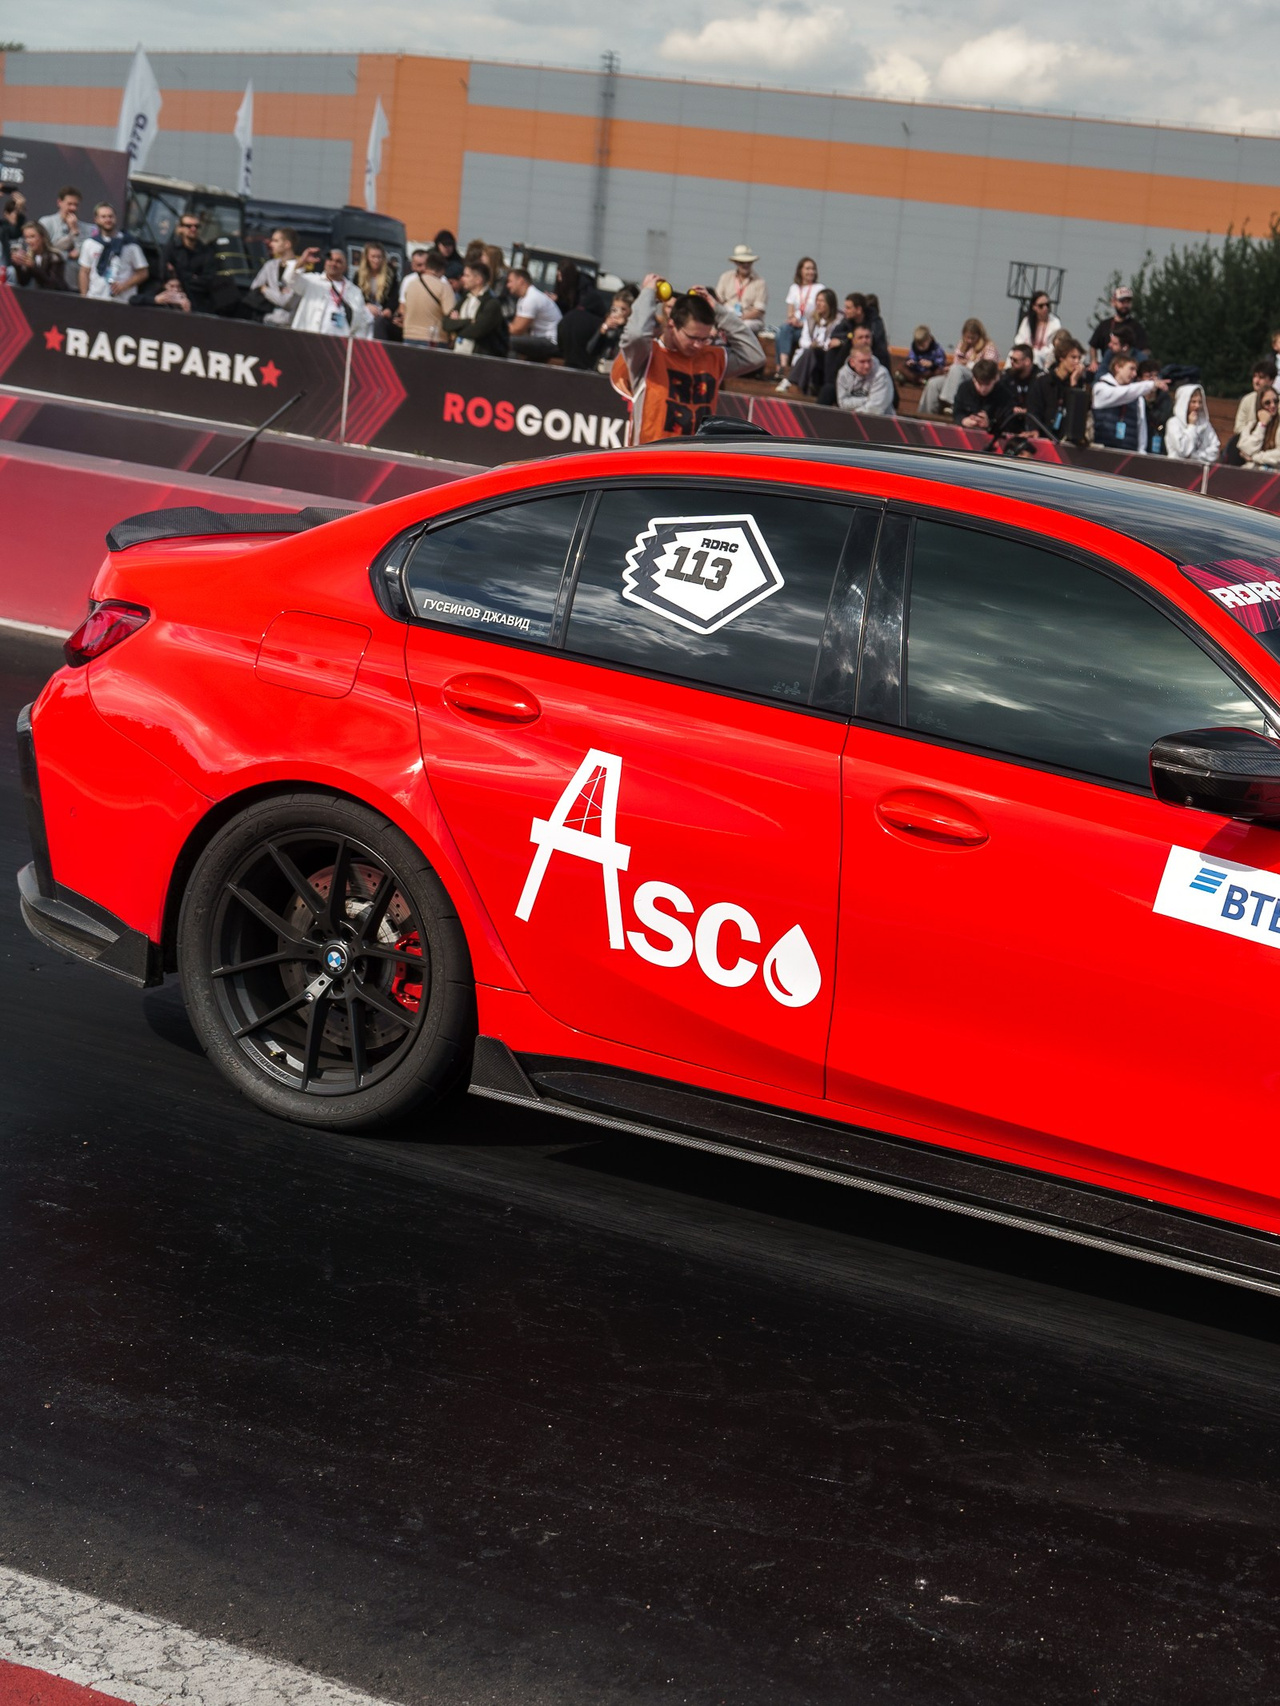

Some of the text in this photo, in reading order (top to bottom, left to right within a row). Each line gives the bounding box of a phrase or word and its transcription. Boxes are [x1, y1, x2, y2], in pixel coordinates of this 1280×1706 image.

[65, 327, 260, 387] RACEPARK
[700, 537, 739, 553] RDRC
[665, 546, 733, 592] 113
[481, 610, 530, 631] ДЖАВИД
